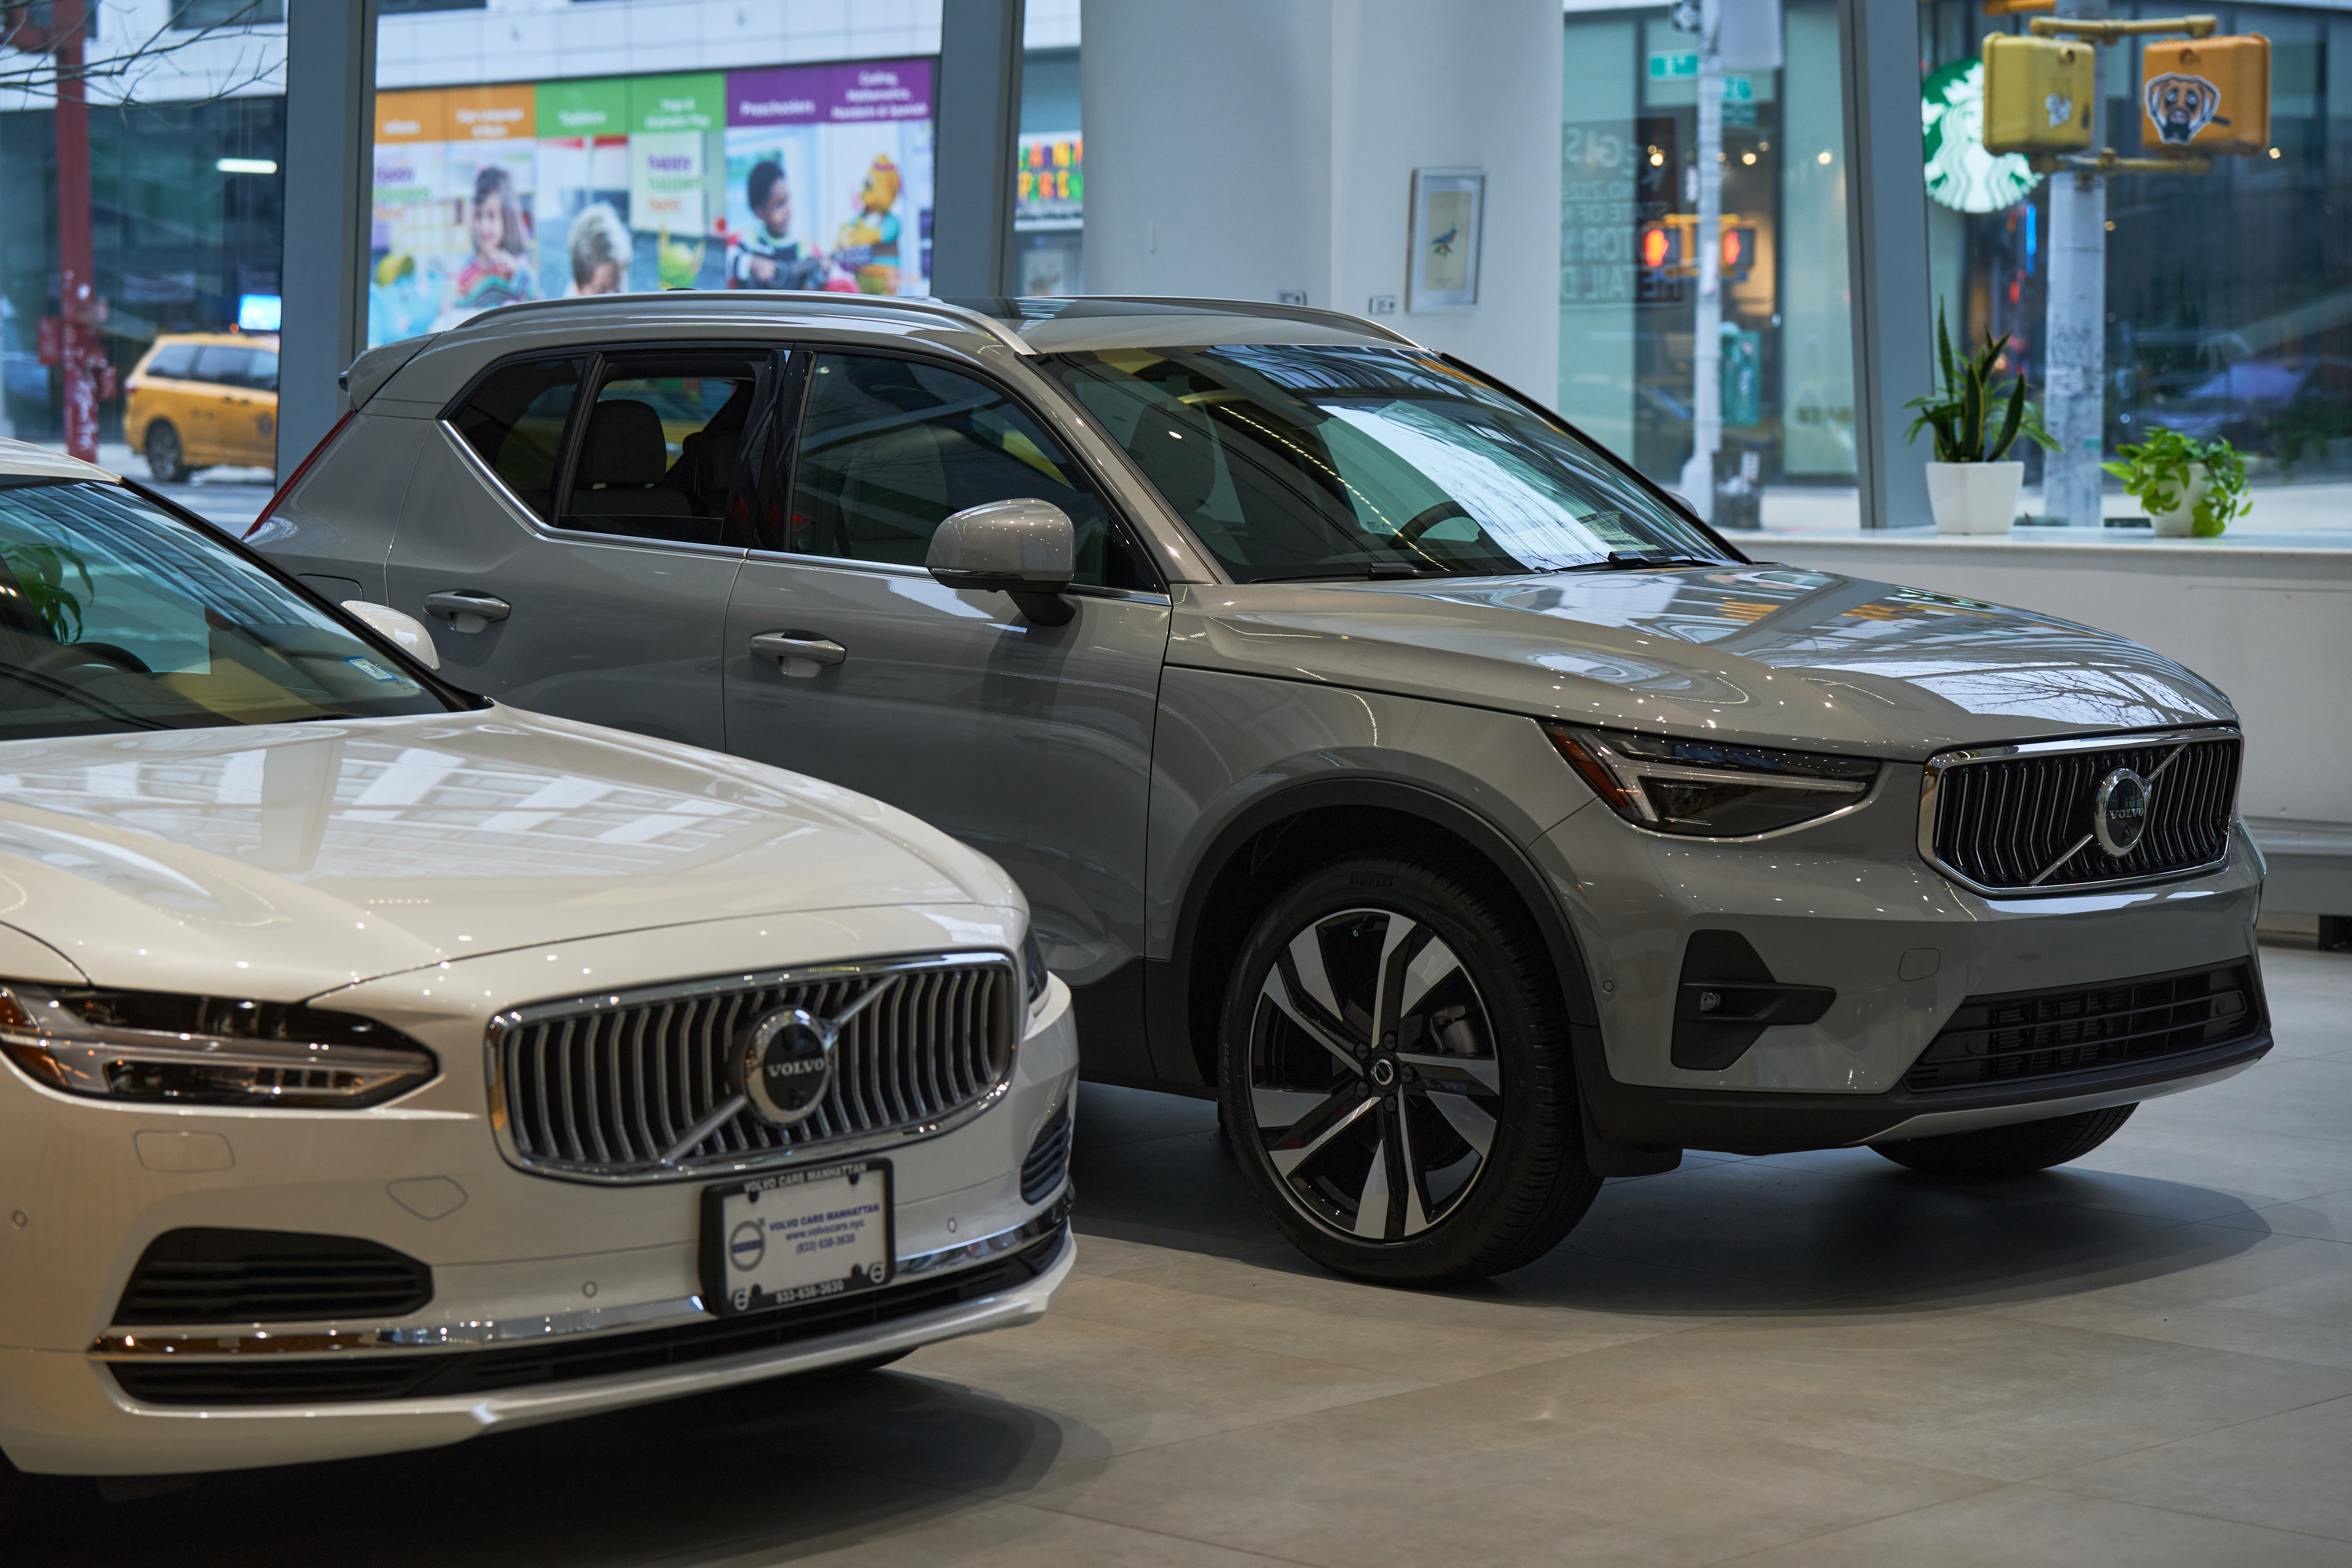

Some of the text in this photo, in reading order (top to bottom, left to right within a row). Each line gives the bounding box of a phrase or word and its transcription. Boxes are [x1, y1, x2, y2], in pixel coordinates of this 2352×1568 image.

[740, 101, 815, 116] Preschoolers
[2109, 808, 2144, 819] VOLVO
[1349, 872, 1394, 887] PIRELLI
[767, 1058, 824, 1078] VOLVO
[744, 1162, 867, 1192] VOLVO CARS MANHATTAN
[769, 1203, 880, 1232] VOLVO CARS MANHATTAN
[776, 1280, 844, 1304] 833-638-3630
